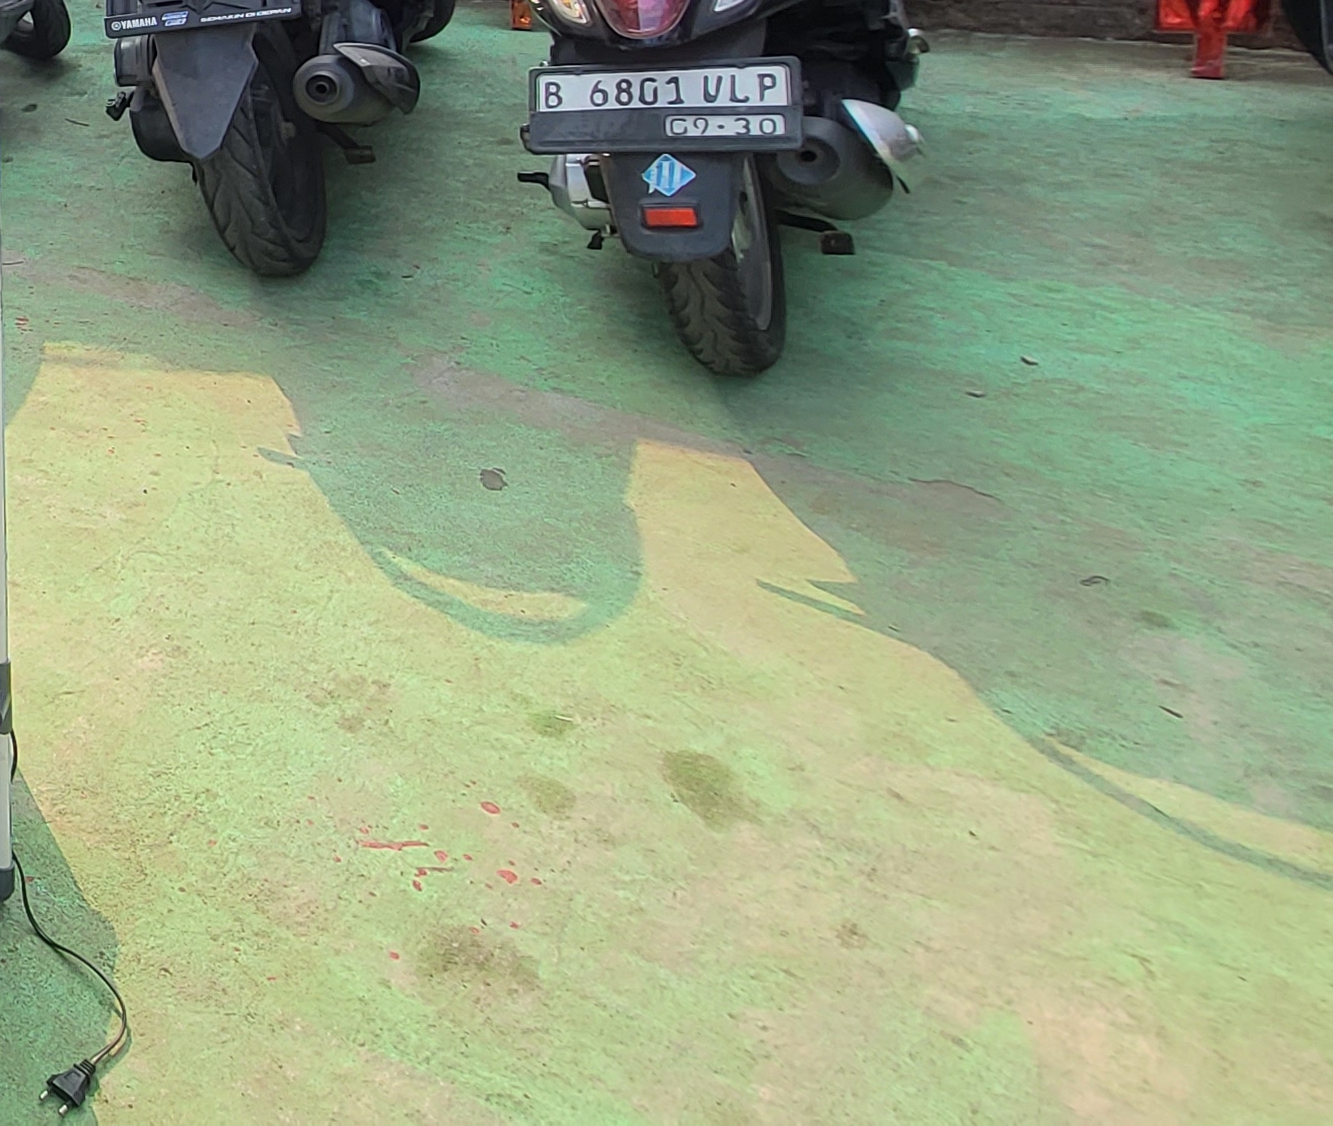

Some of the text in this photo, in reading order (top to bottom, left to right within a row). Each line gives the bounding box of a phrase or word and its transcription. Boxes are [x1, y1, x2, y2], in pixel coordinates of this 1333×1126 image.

[121, 16, 158, 30] YAMAHA
[544, 81, 564, 110] B
[589, 75, 686, 108] 6801
